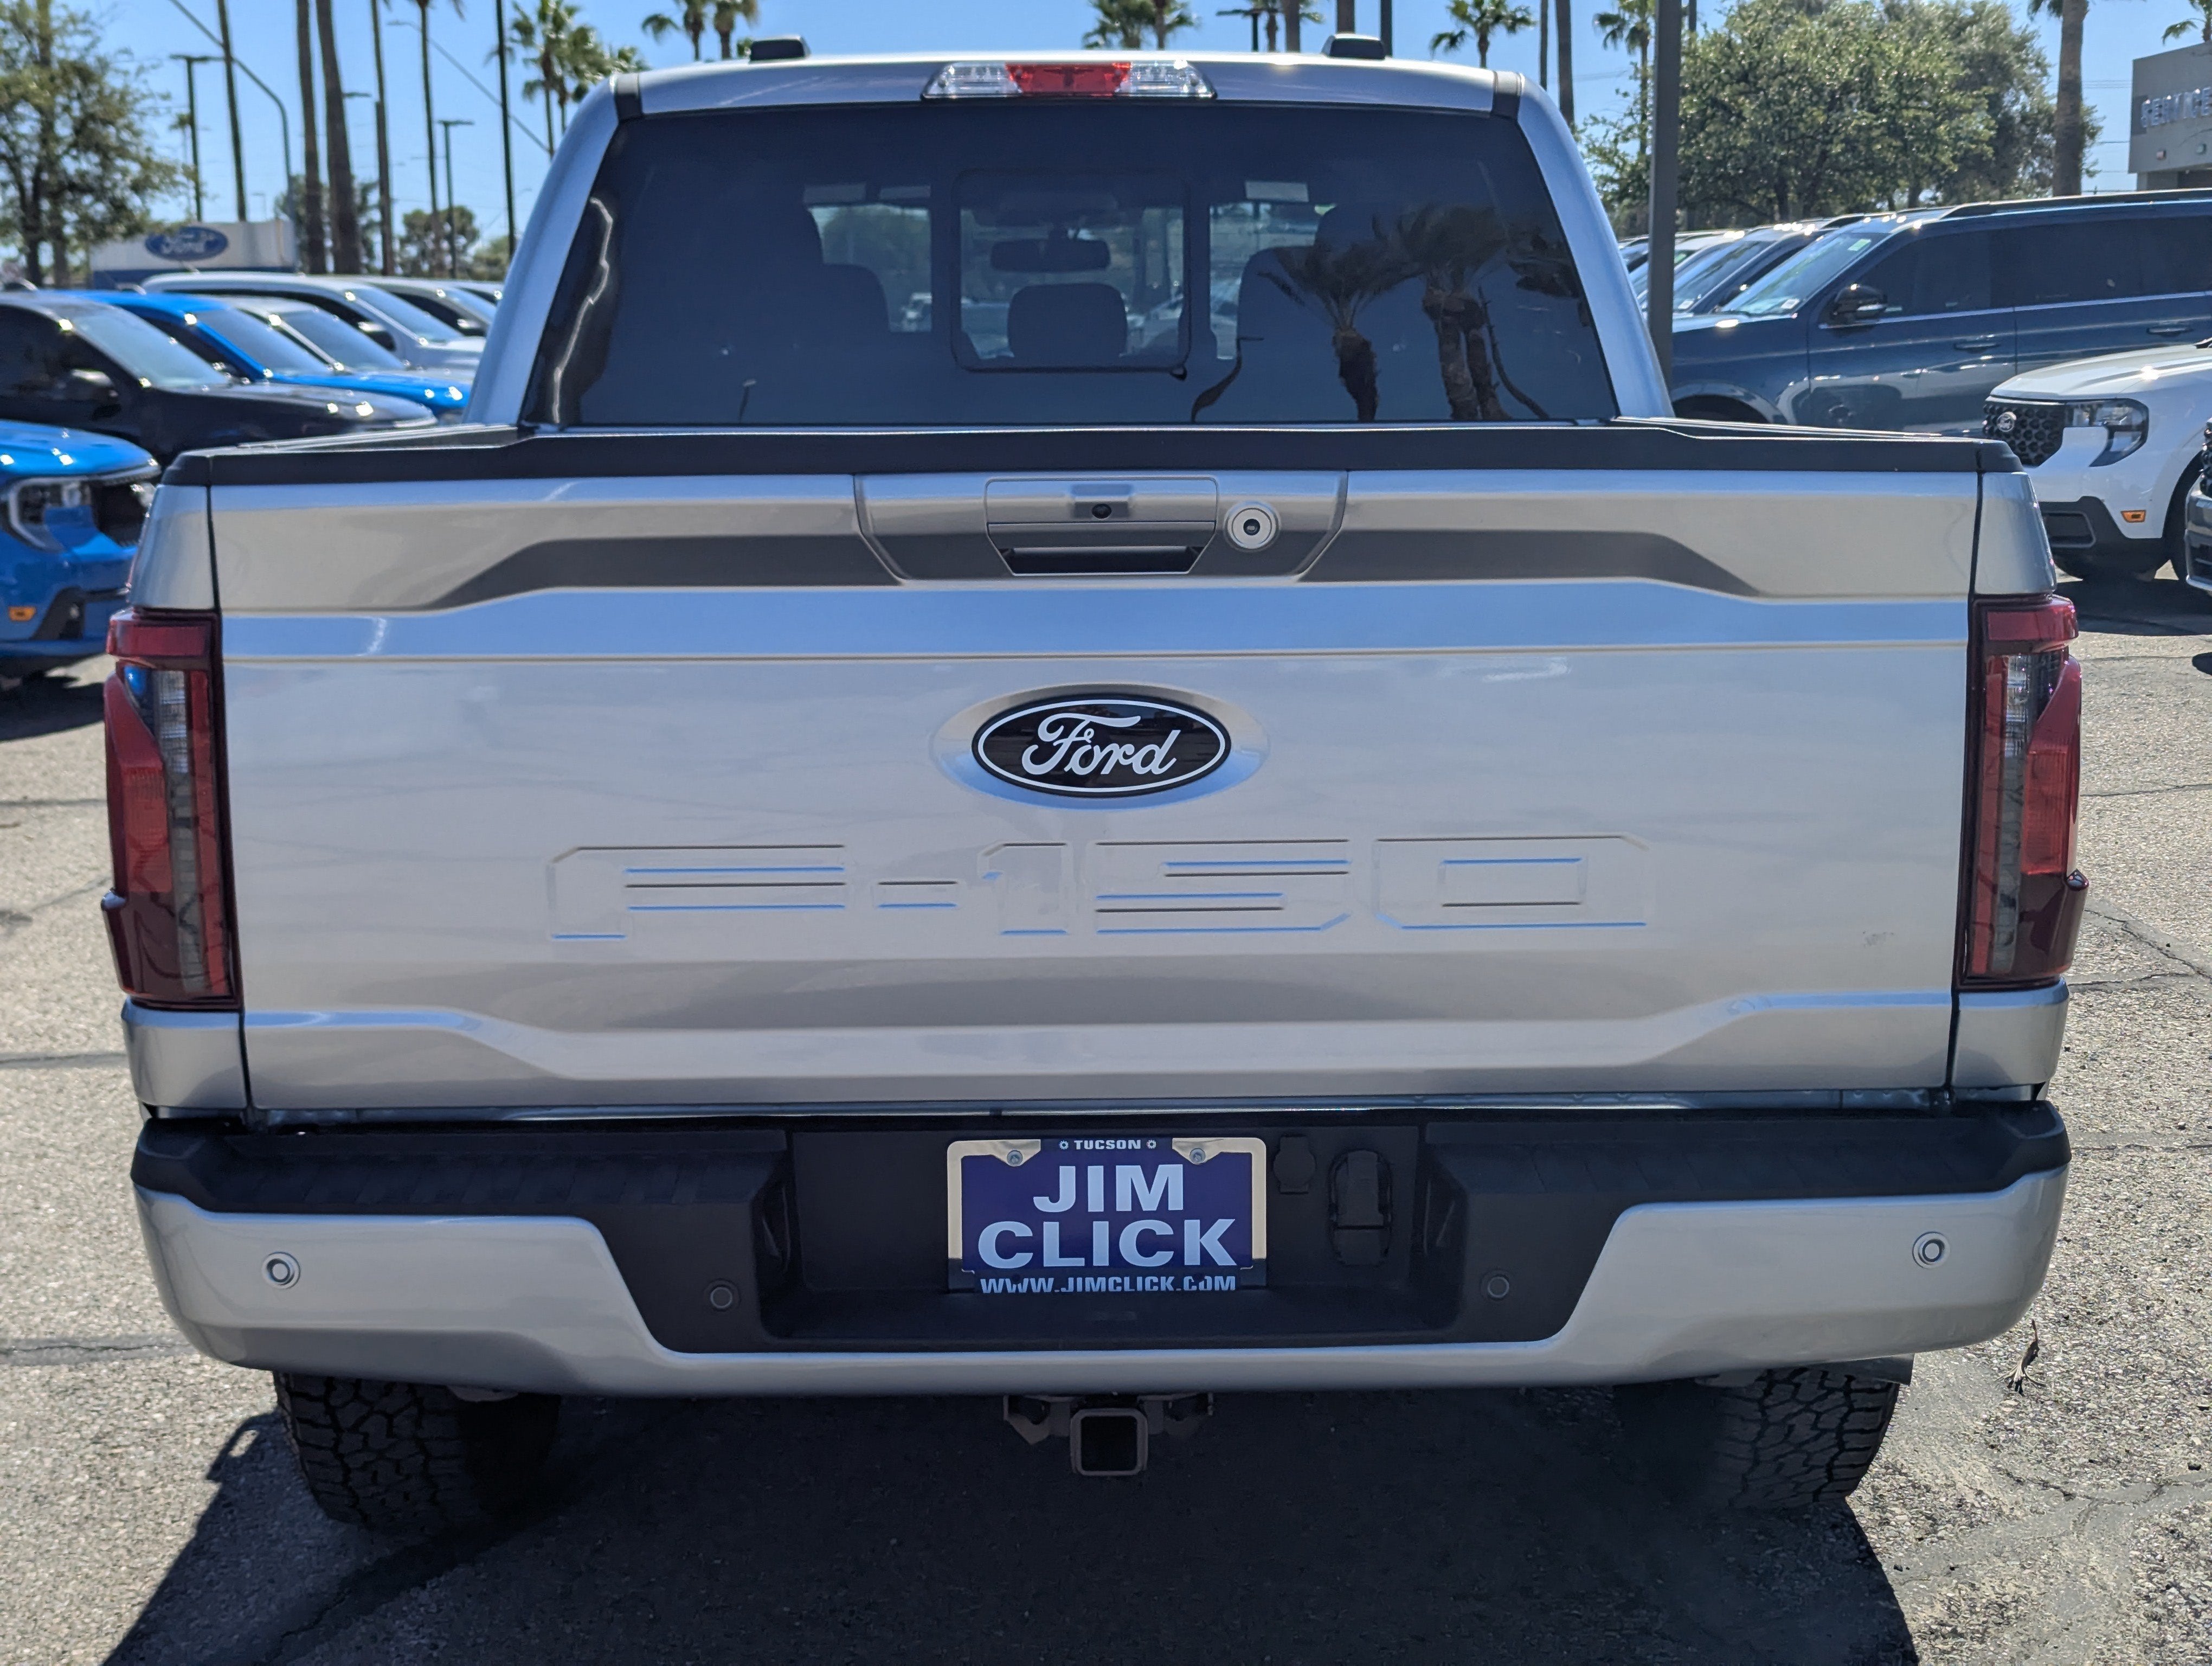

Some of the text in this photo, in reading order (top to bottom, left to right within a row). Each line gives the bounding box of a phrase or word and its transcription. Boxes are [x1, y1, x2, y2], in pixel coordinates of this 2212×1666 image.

[1022, 713, 1181, 776] Ford
[547, 836, 1650, 938] F-150
[1074, 1139, 1141, 1150] TUCSON
[1033, 1164, 1184, 1213] JIM
[978, 1219, 1237, 1268] CLICK
[980, 1276, 1236, 1293] WWW.JIMCLICK.COM
